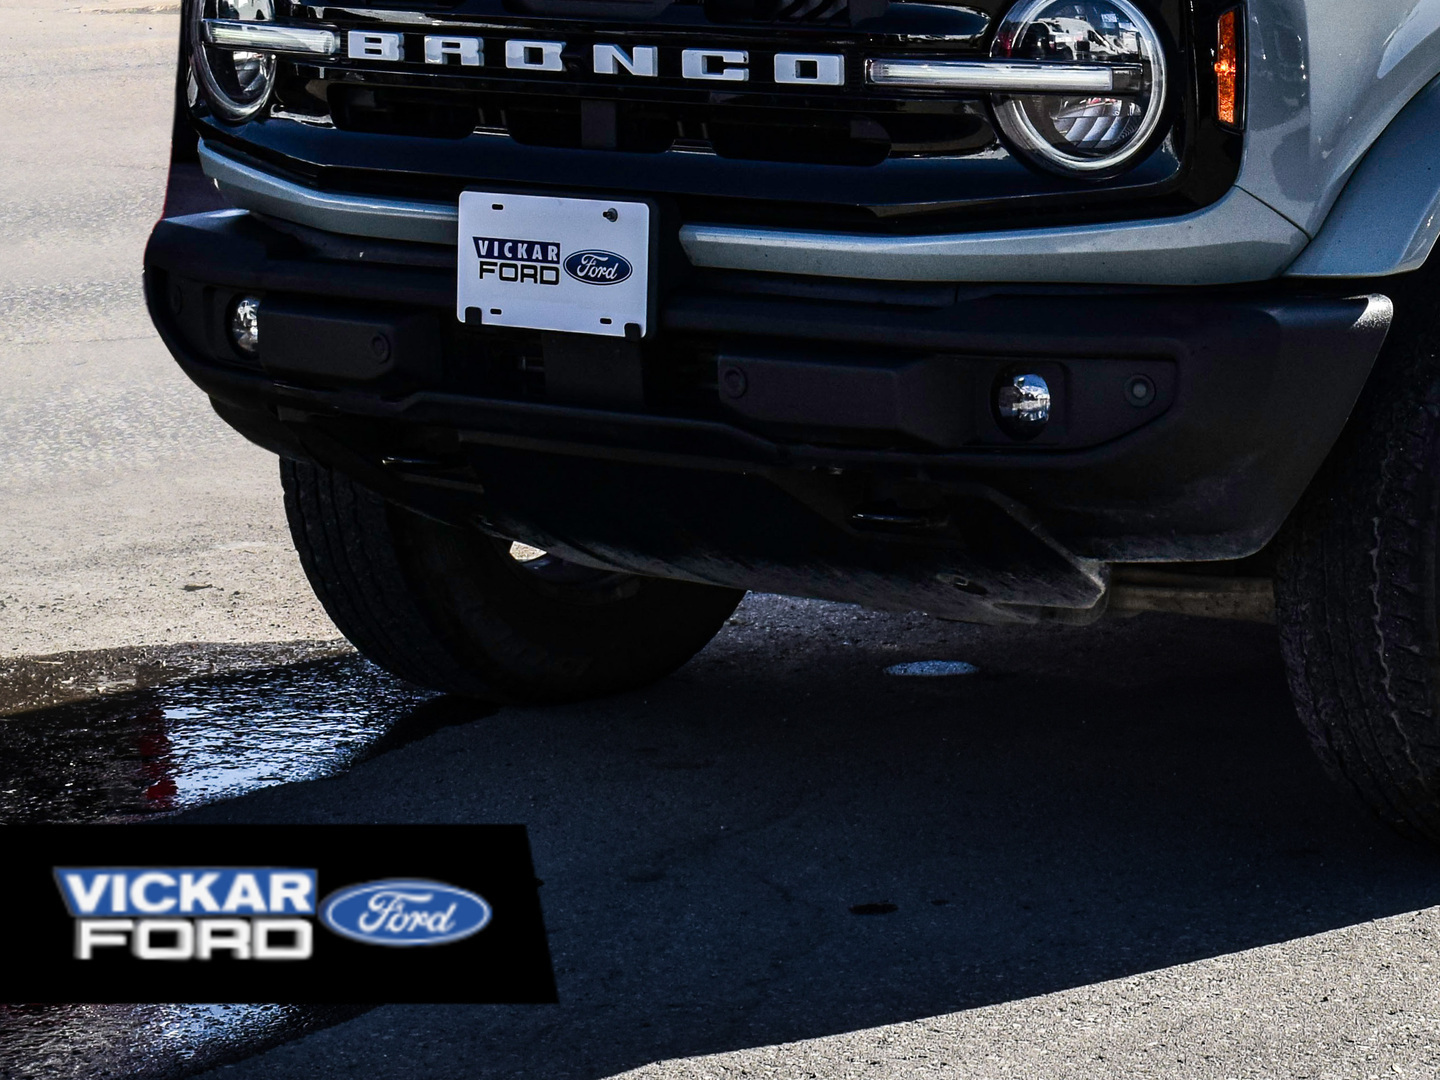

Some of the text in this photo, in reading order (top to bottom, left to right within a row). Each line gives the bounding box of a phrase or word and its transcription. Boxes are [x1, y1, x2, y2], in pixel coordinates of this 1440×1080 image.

[347, 29, 845, 86] BRONCO
[478, 240, 559, 262] VICKAR
[479, 261, 560, 286] FORD
[576, 253, 619, 280] Ford
